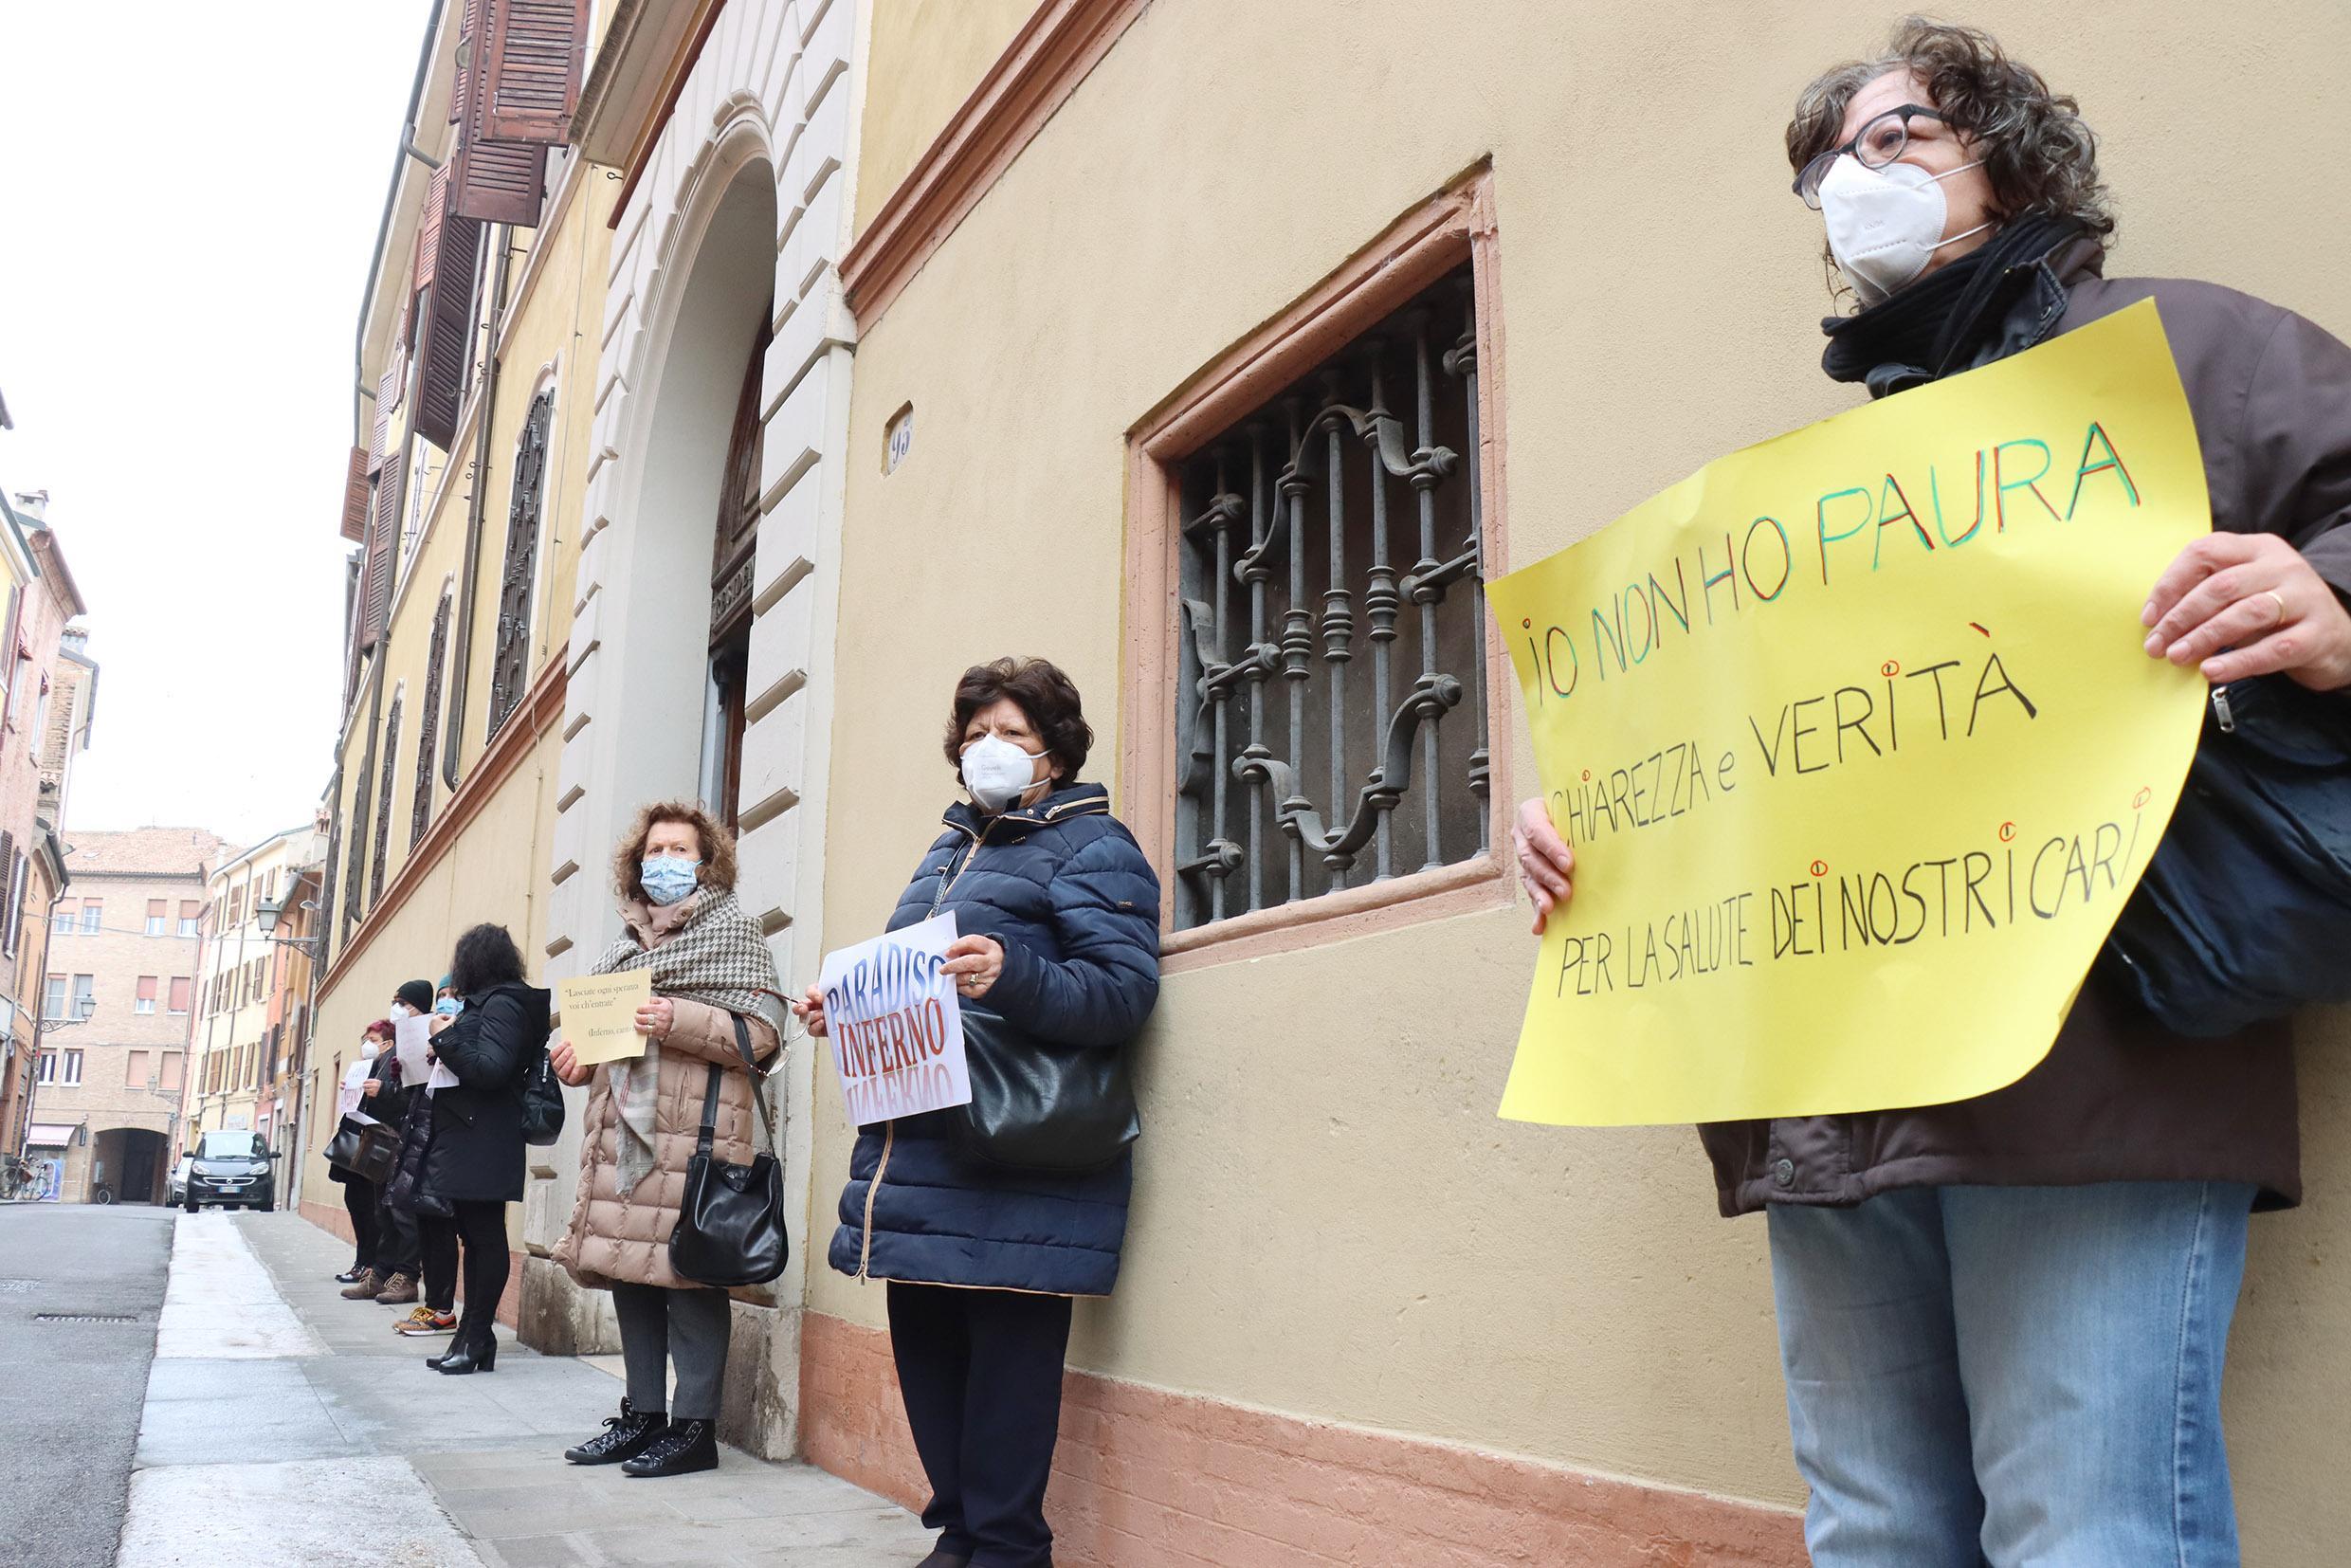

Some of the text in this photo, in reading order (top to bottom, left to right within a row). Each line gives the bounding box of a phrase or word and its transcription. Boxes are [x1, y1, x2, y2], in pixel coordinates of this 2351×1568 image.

[1592, 556, 1689, 681] NON
[1699, 516, 1792, 626] HO
[1817, 422, 2141, 586] PAURA
[1718, 751, 1736, 793] e
[827, 942, 947, 1031] PARADISO
[1558, 932, 1613, 998] PER
[838, 997, 946, 1078] INFERNO
